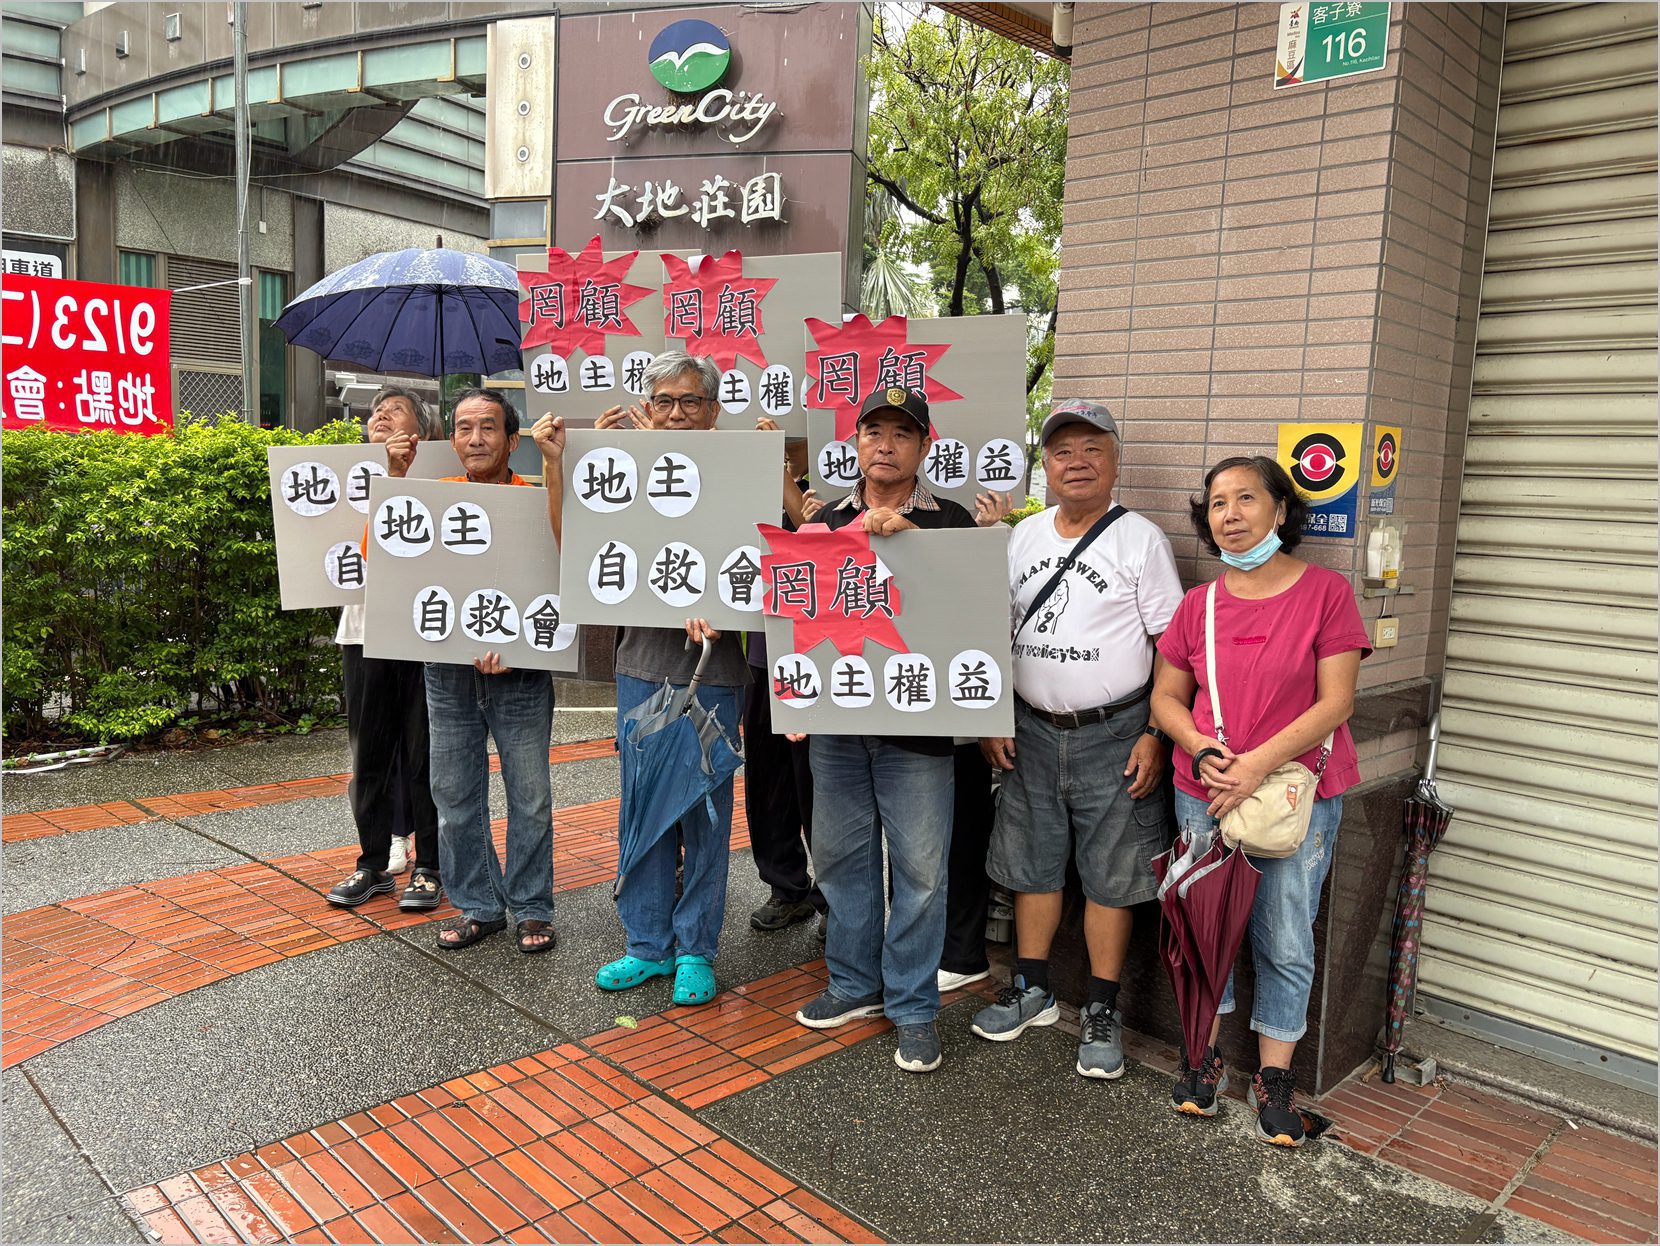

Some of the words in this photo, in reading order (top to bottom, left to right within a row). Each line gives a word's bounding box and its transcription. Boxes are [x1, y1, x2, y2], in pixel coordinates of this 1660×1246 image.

[1322, 28, 1367, 62] 116
[593, 172, 783, 228] 大地莊園
[528, 279, 622, 329] 罔顧
[670, 283, 758, 338] 罔顧
[720, 370, 807, 411] 主權
[581, 456, 692, 504] 地主
[823, 441, 1018, 484] 地權益
[380, 500, 487, 547] 地主
[597, 542, 761, 605] 自救會
[771, 557, 895, 620] 罔顧
[420, 590, 560, 649] 自救會
[774, 660, 996, 706] 地主權益
